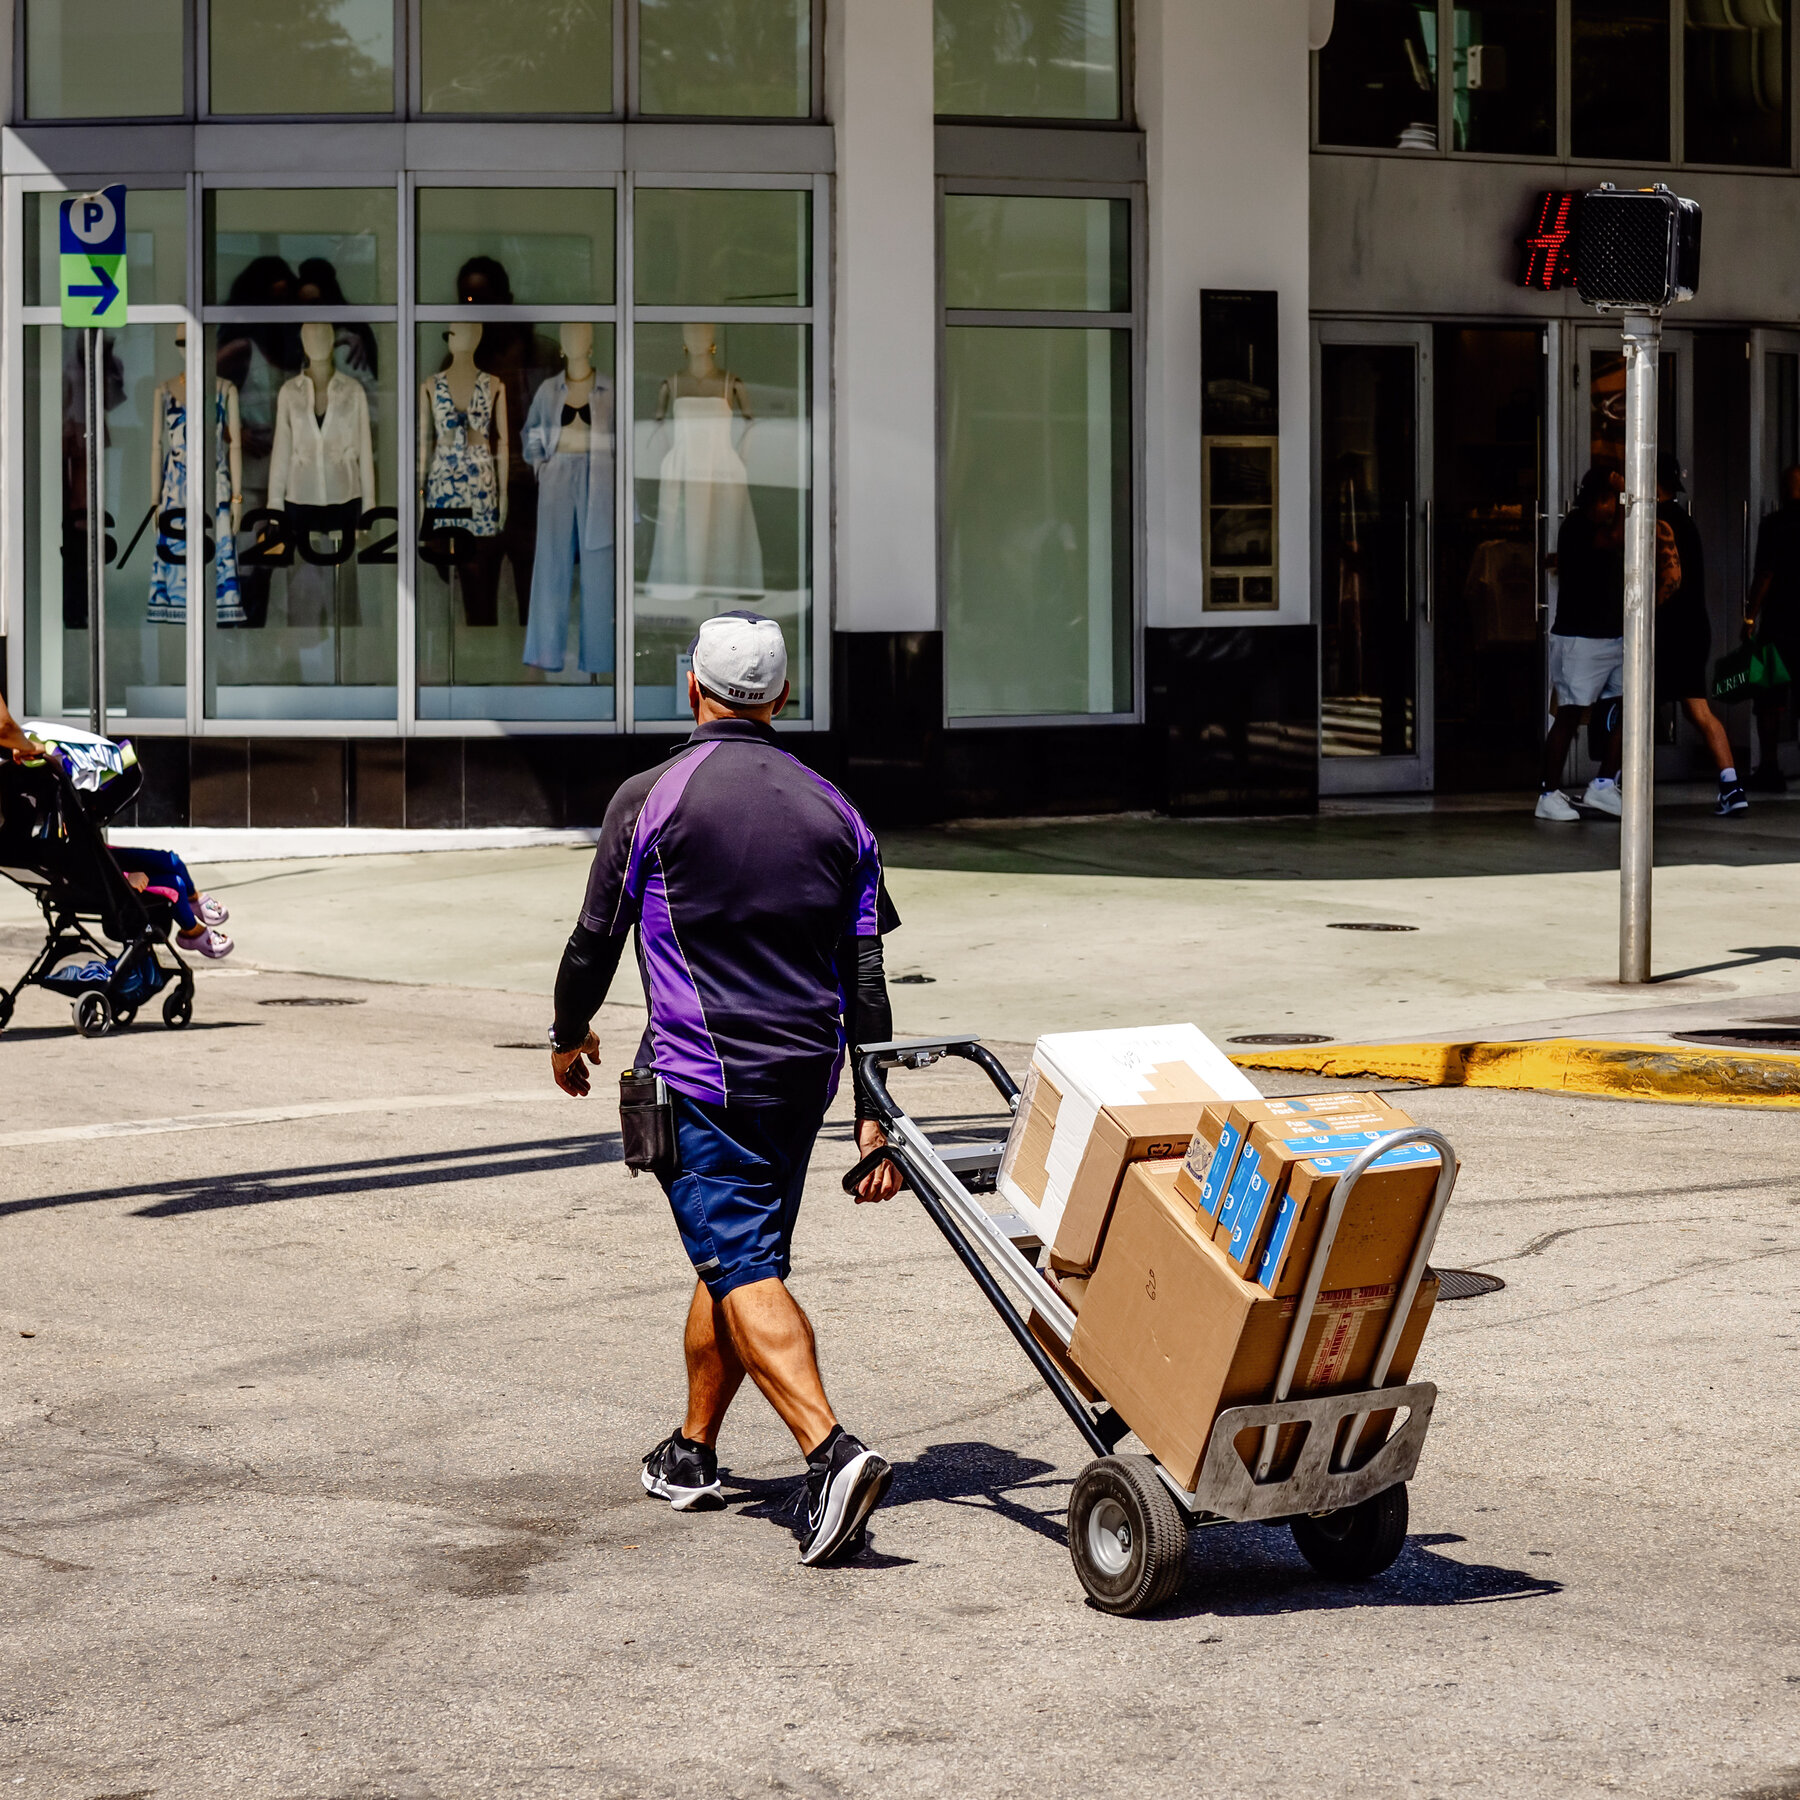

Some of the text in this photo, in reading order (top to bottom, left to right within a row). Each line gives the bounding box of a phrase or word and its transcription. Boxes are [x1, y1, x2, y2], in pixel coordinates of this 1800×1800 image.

[83, 202, 104, 233] P
[237, 506, 476, 567] 2025
[727, 687, 766, 700] RED SOX
[1328, 1324, 1348, 1357] WARNING
